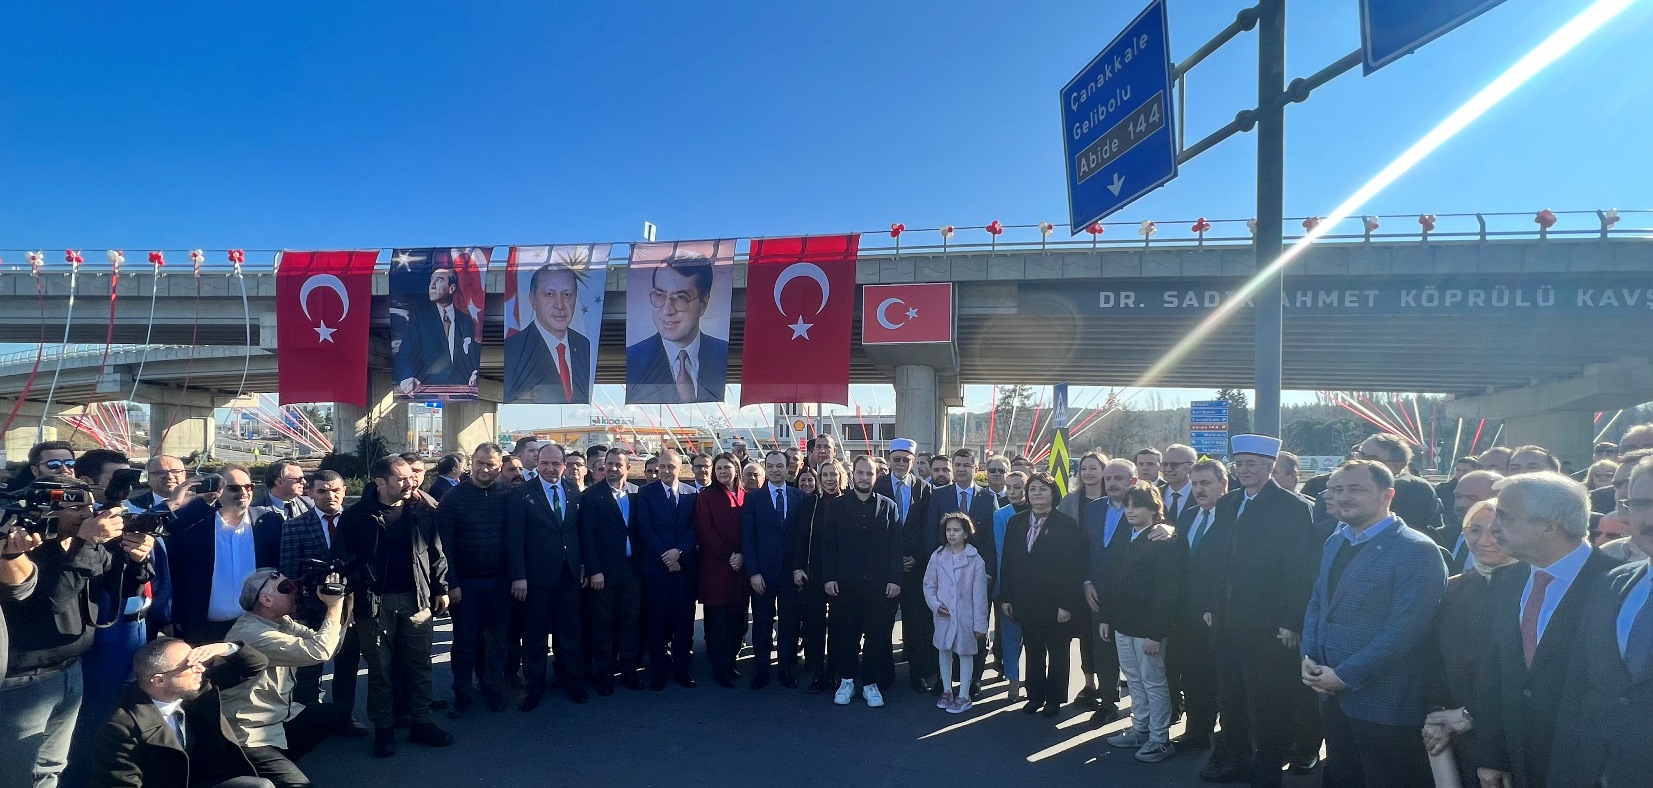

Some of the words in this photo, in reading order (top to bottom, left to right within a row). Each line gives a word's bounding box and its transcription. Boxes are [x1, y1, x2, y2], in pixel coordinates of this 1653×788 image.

[1070, 33, 1148, 111] Çanakkale
[1073, 85, 1131, 140] Gelibolu
[1079, 138, 1119, 176] Abide
[1128, 103, 1160, 139] 144
[1099, 291, 1145, 308] DR.
[1400, 285, 1555, 307] KÖPRÜLÜ
